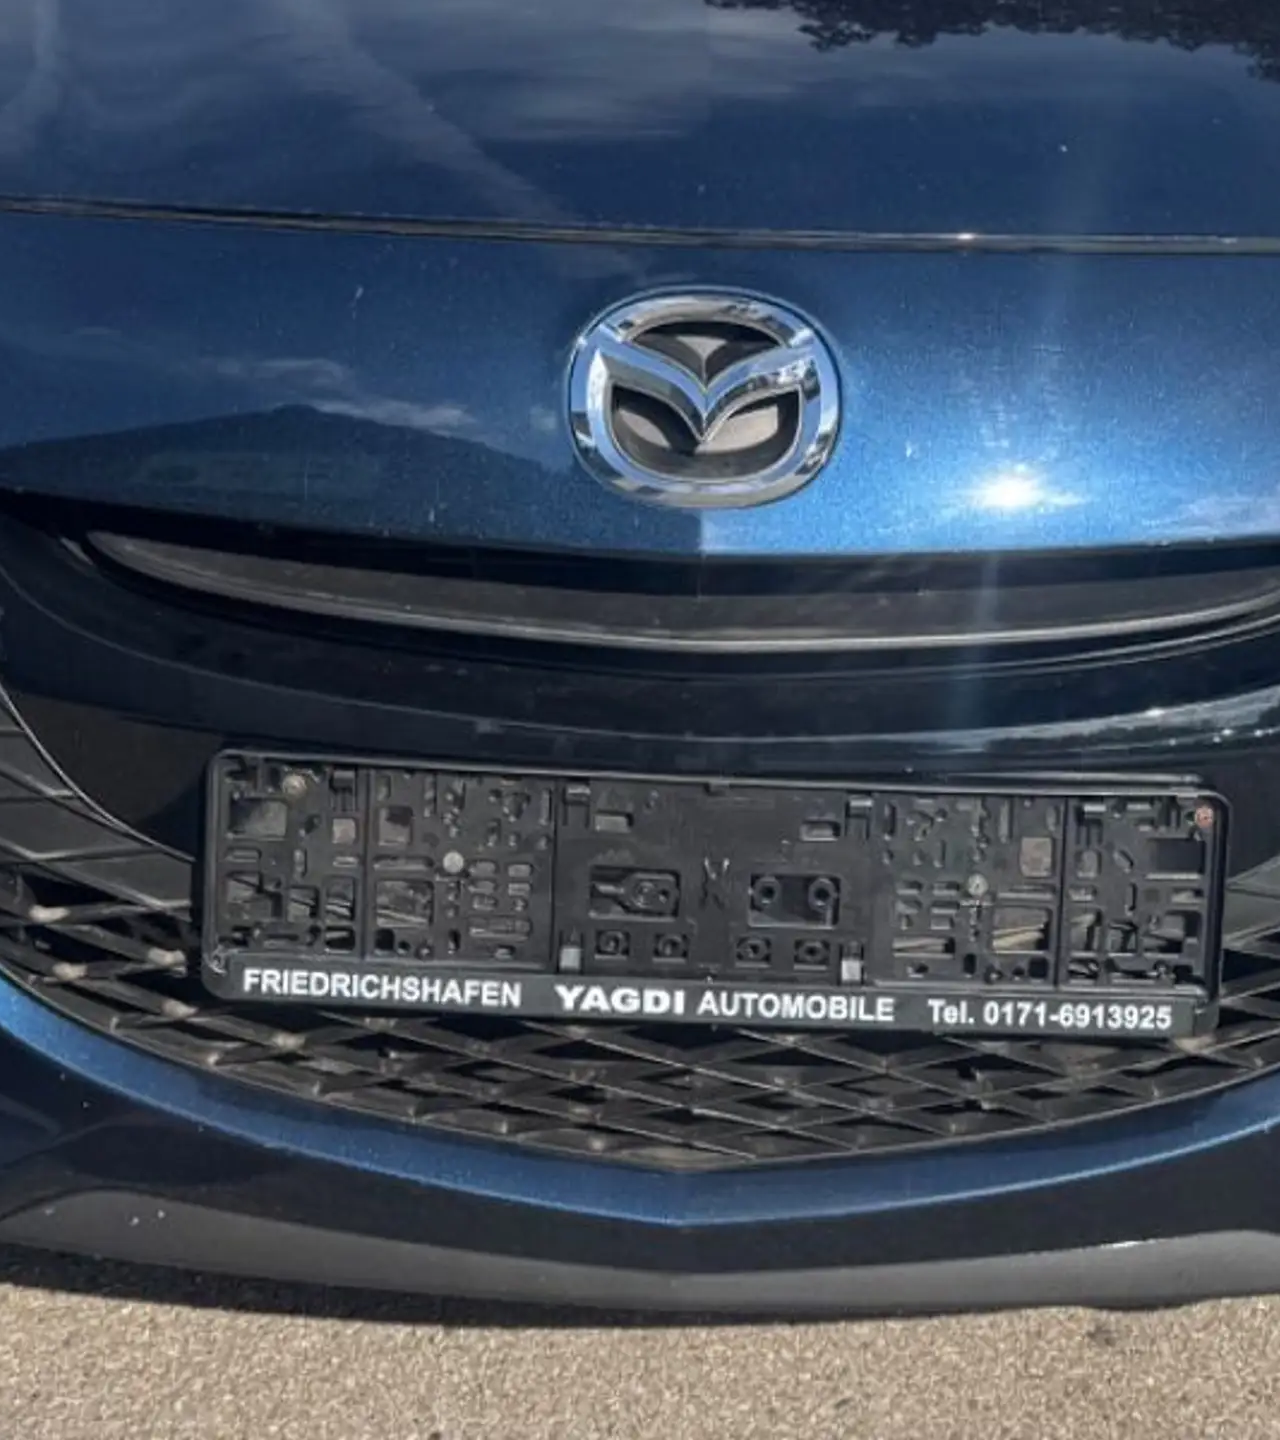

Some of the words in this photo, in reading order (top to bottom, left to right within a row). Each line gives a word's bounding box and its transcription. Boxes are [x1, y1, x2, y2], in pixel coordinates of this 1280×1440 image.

[243, 968, 522, 1008] FRIEDRICHSHAFEN
[554, 984, 685, 1015] YAGDI
[696, 990, 895, 1022] AUTOMOBILE
[928, 998, 975, 1024] Tel.
[983, 1001, 1172, 1030] 0171-6913925
